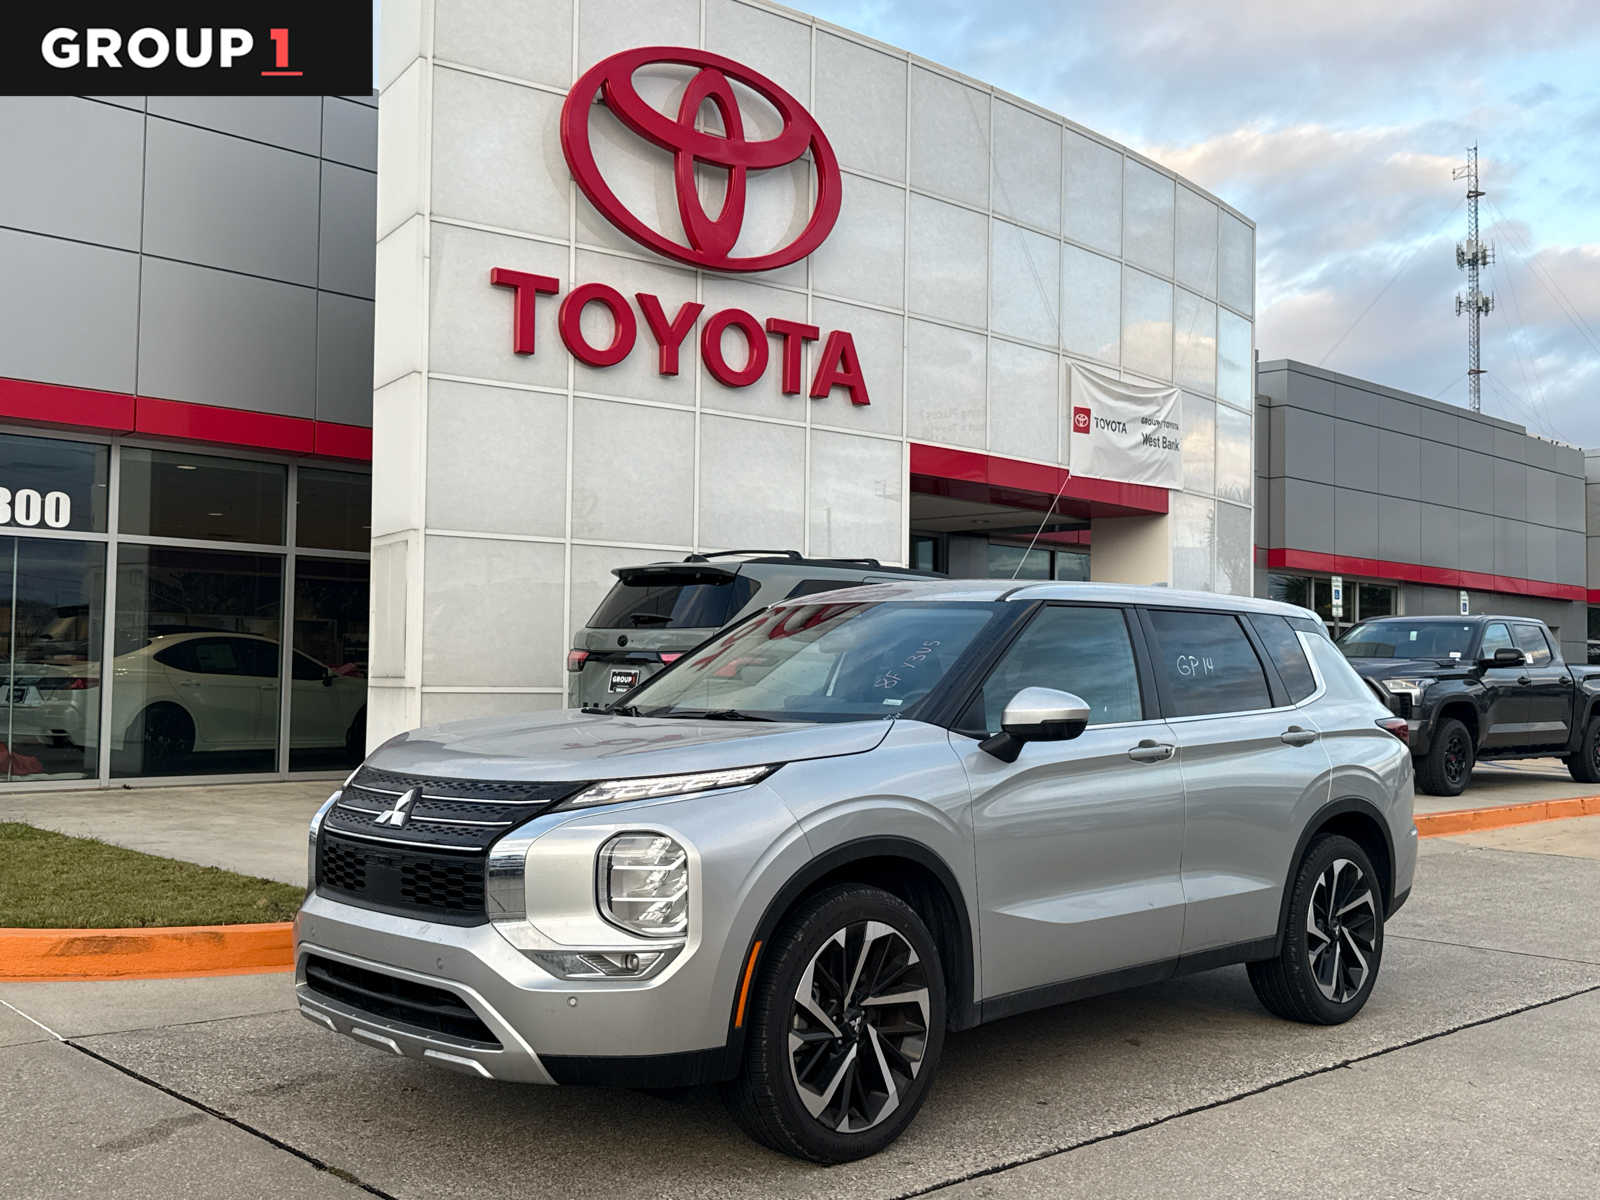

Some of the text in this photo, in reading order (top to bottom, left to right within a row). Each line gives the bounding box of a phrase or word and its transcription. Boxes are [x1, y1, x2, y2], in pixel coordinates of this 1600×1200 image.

[490, 266, 871, 406] TOYOTA
[1094, 416, 1127, 434] TOYOTA
[1141, 432, 1180, 452] West Bank
